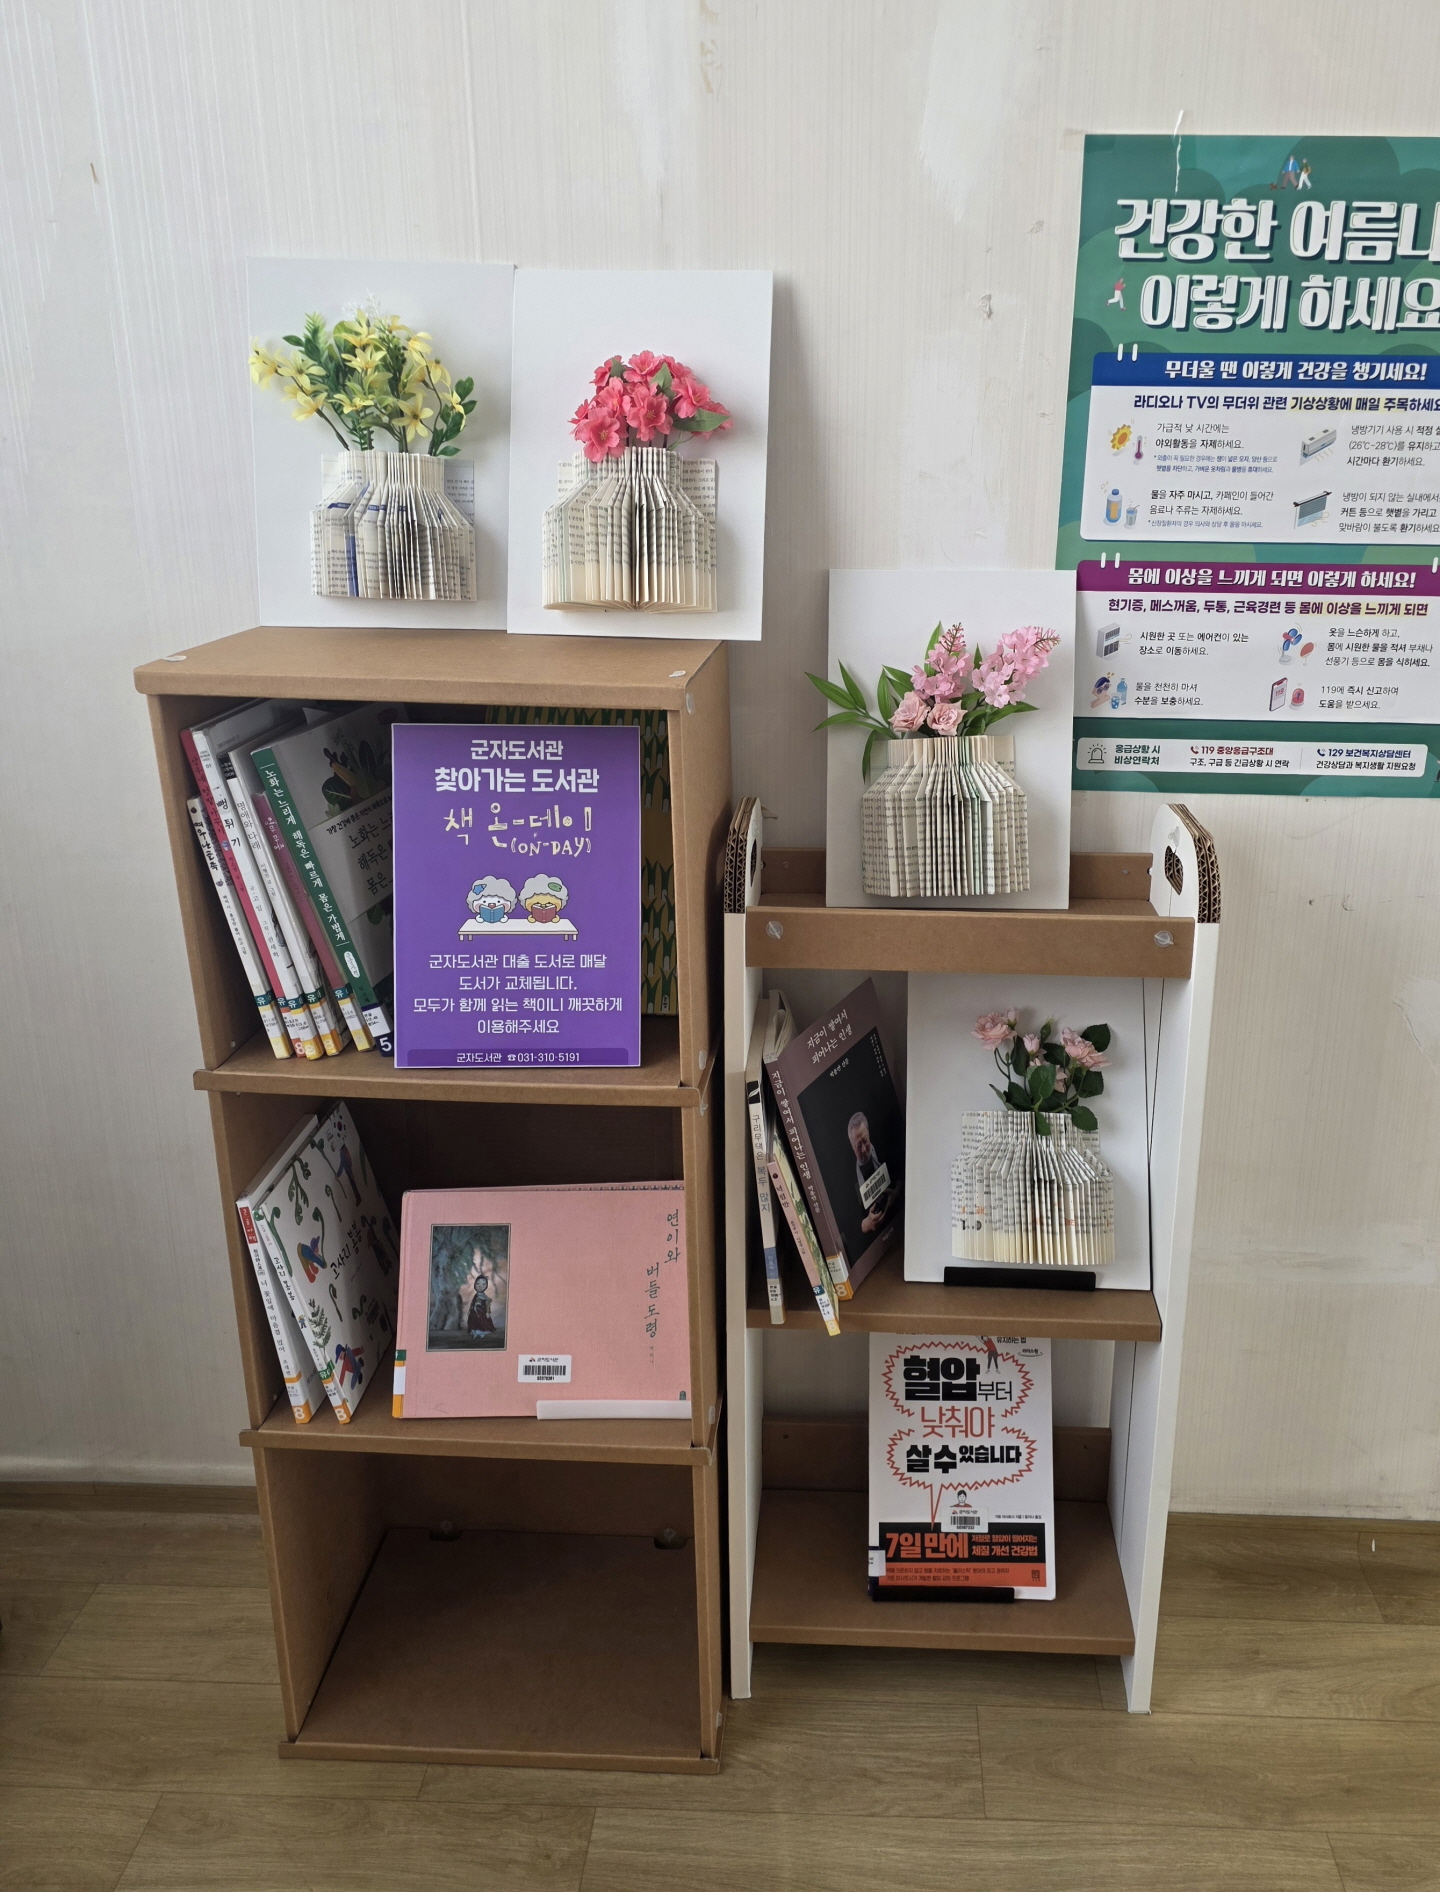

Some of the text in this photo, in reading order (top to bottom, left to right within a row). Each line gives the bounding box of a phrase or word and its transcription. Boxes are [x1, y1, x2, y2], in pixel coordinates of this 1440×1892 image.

[1115, 198, 1279, 261] 건강한
[1140, 274, 1440, 331] 이렇게 하세요
[1165, 360, 1428, 381] 무더울 땐 이렇게 건강을 챙기세요!
[1134, 395, 1440, 411] 라디오나 TV의 무더위 관련 기상상황에 매일 주목하세요
[1157, 424, 1229, 433] 가급적 낮 시간에는
[1155, 439, 1244, 449] 야외활동을 자제하세요.
[1151, 490, 1274, 501] 물을 자주 마시고, 카페인이 들어간
[1150, 506, 1243, 515] 음료나 주류는 자제하세요.
[1128, 568, 1416, 588] 몸에 이상을 느끼게 되면 이렇게 하세요!
[1109, 599, 1428, 616] 현기증, 메스꺼움, 두통, 근육경련 등 몸에 이상을 느끼게 되면
[1140, 632, 1249, 642] 시원한 곳 또는 에어컨이 있는
[1139, 646, 1208, 655] 장소로 이동하세요.
[1136, 683, 1197, 692] 물을 천천히 마셔
[1322, 686, 1399, 695] 119에 즉시 신고하여
[1134, 697, 1203, 706] 수분을 보충하세요.
[1319, 700, 1380, 709] 도움을 받으세요.
[470, 740, 563, 760] 군자도서관
[1115, 745, 1160, 753] 응급상황 시
[1202, 746, 1274, 755] 119 중앙응급구조대
[1328, 749, 1411, 758] 129 보건복지상담센터
[1114, 756, 1159, 765] 비상연락처
[1190, 758, 1207, 766] 구조,
[1209, 758, 1223, 766] 구급
[1234, 759, 1264, 768] 긴급상황
[1275, 760, 1290, 768] 연락
[1316, 761, 1416, 770] 건강상담과 복지생활 지원요청
[434, 767, 599, 793] 찾아가는 도서관
[443, 807, 473, 845] 책
[349, 822, 379, 849] 노화는
[511, 837, 592, 857] (ON-DAY)
[265, 770, 284, 797] 노화는
[278, 800, 297, 825] 느리게
[318, 893, 332, 913] 몸은
[327, 914, 346, 941] 가볍게
[357, 844, 388, 871] 해독은
[367, 873, 388, 895] 몸은
[429, 954, 607, 969] 군자도서관 대출 도서로 매달
[459, 976, 577, 991] 도서가 교체됩니다.
[414, 998, 622, 1013] 모두가 함께 읽는 책이니 깨끗하게
[477, 1020, 559, 1034] 이용해주세요
[839, 1024, 852, 1040] 인생
[380, 1037, 391, 1052] 5
[806, 1026, 828, 1049] 지금이
[457, 1053, 502, 1063] 군자도서관
[772, 1070, 786, 1096] 지금이
[800, 1163, 811, 1179] 인생
[664, 1209, 680, 1264] 연이와
[273, 1257, 286, 1277] 고사리
[836, 1285, 847, 1296] 8
[903, 1355, 1012, 1402] 혈압부터
[294, 1407, 305, 1419] 8
[335, 1408, 347, 1420] 8
[921, 1406, 995, 1438] 낮춰야
[959, 1445, 1022, 1464] 있습니다
[972, 1546, 1038, 1556] 체질 개선 건강법
